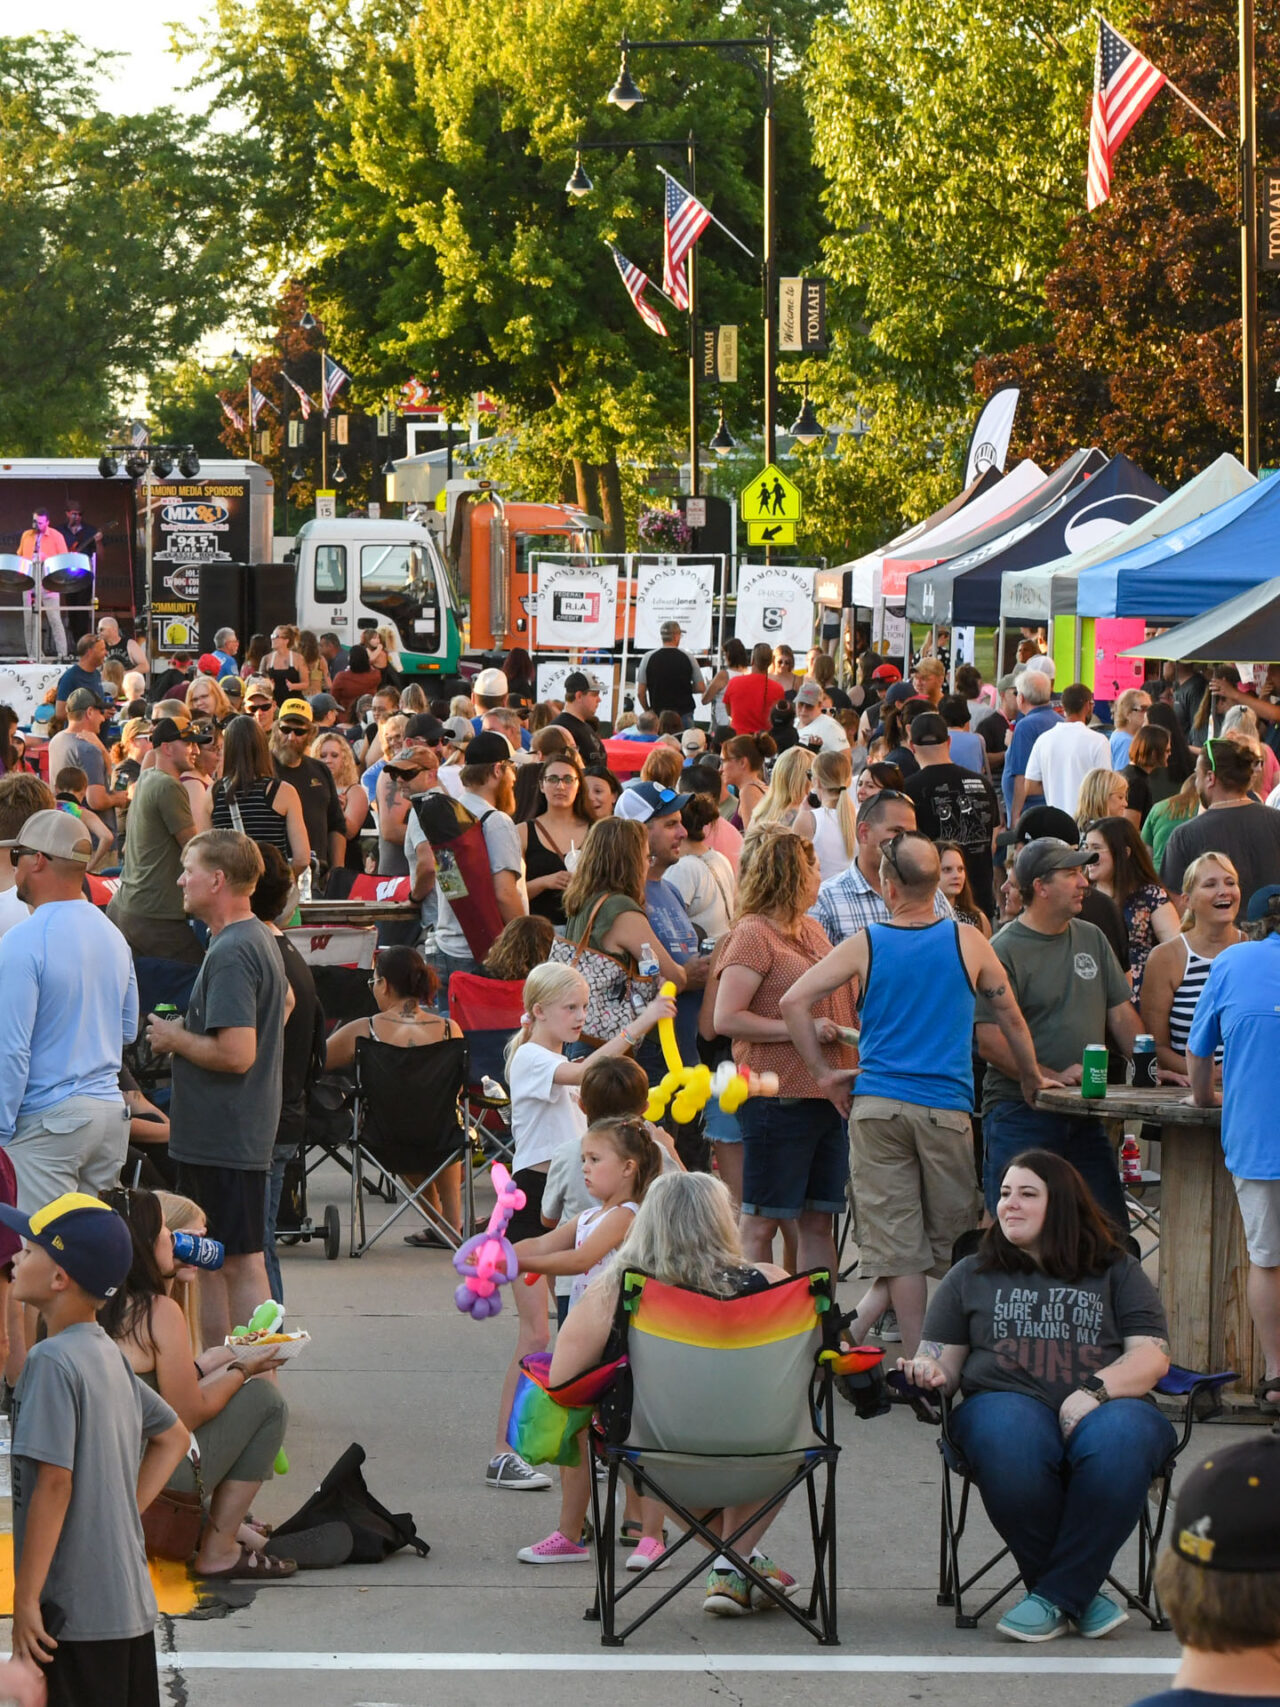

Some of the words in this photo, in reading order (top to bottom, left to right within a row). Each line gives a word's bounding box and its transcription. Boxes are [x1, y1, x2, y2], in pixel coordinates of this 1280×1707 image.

[782, 298, 794, 343] Welcome
[788, 286, 795, 297] to
[808, 285, 820, 343] TOMAH
[704, 331, 714, 376] TOMAH
[142, 486, 177, 497] DAMOND
[179, 486, 202, 496] MEDIA
[204, 486, 244, 497] SPONSORS
[177, 536, 209, 547] 94.5
[539, 568, 575, 599] DIAMOND
[579, 569, 615, 604] SPONSOR
[554, 591, 583, 599] FEDERAL
[638, 568, 676, 603] DIAMOND
[680, 569, 711, 604] SPONSOR
[743, 569, 788, 592] DIAMOND
[791, 571, 811, 599] MEDIA
[151, 602, 197, 613] COMMUNITY
[37, 667, 62, 690] GOLD
[541, 669, 566, 694] SILVER
[995, 1288, 1002, 1304] I
[1010, 1288, 1039, 1304] AM
[1048, 1287, 1104, 1312] 1776%
[993, 1302, 1033, 1321] SURE
[1041, 1303, 1064, 1322] NO
[1072, 1307, 1103, 1331] ONE
[993, 1321, 1008, 1339] IS
[1015, 1320, 1070, 1340] TAKING
[1076, 1327, 1100, 1345] MY
[993, 1338, 1103, 1384] GUNS
